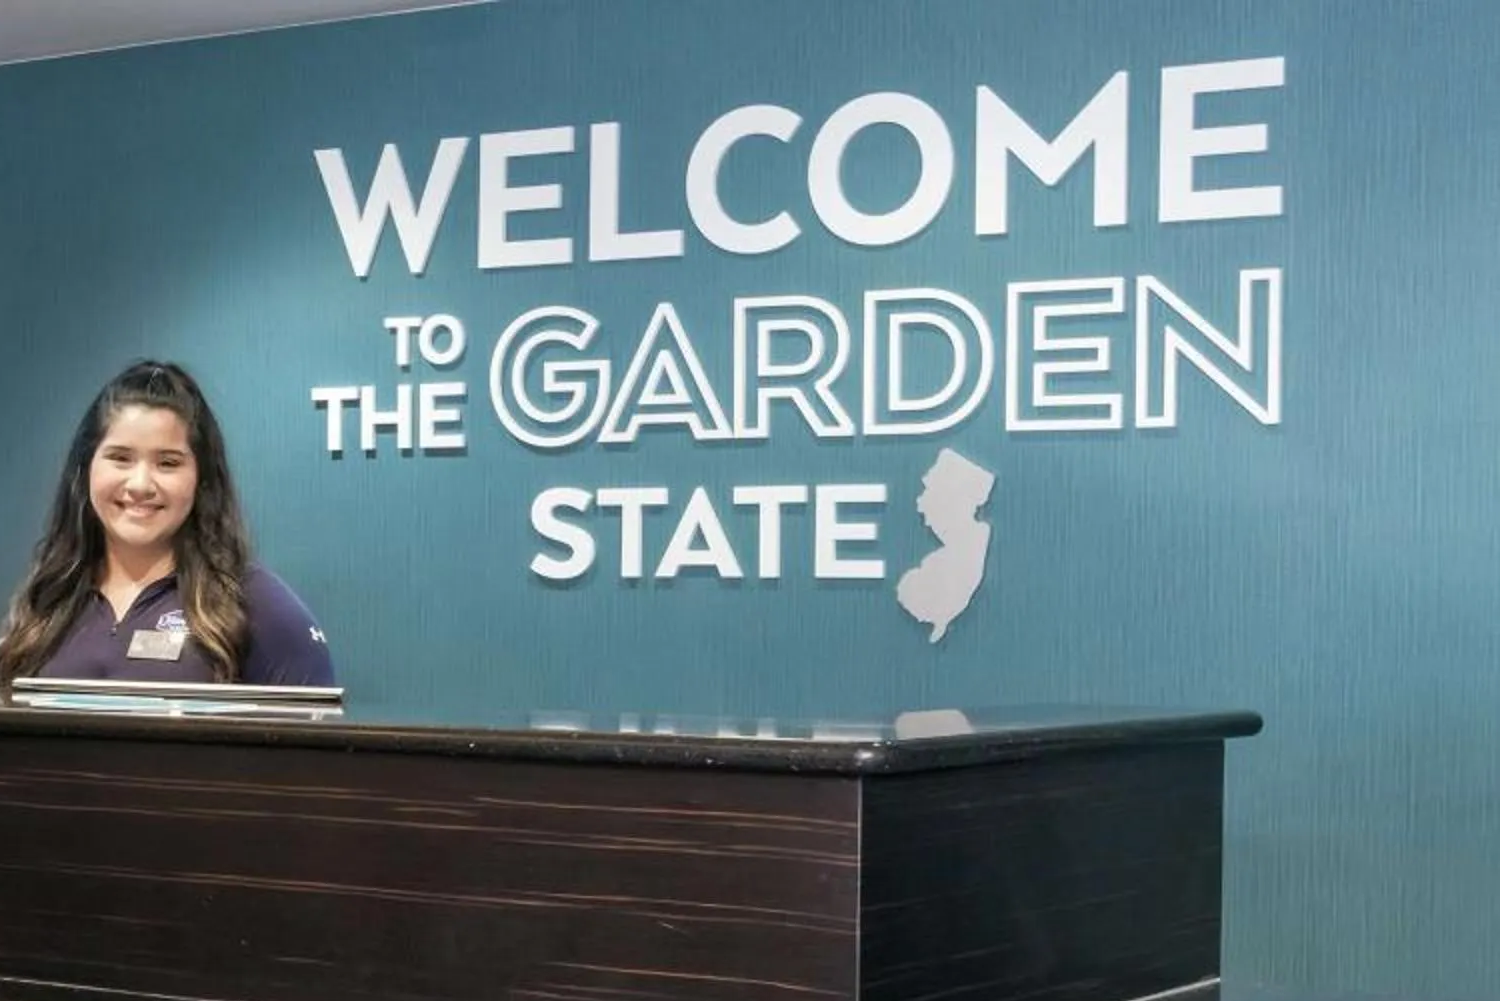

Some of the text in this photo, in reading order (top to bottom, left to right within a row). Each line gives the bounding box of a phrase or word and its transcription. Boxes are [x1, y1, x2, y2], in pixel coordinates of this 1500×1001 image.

[313, 56, 1286, 278] WELCOME
[384, 313, 466, 366] TO
[489, 267, 1283, 448] GARDEN
[311, 382, 466, 450] THE
[529, 483, 888, 580] STATE
